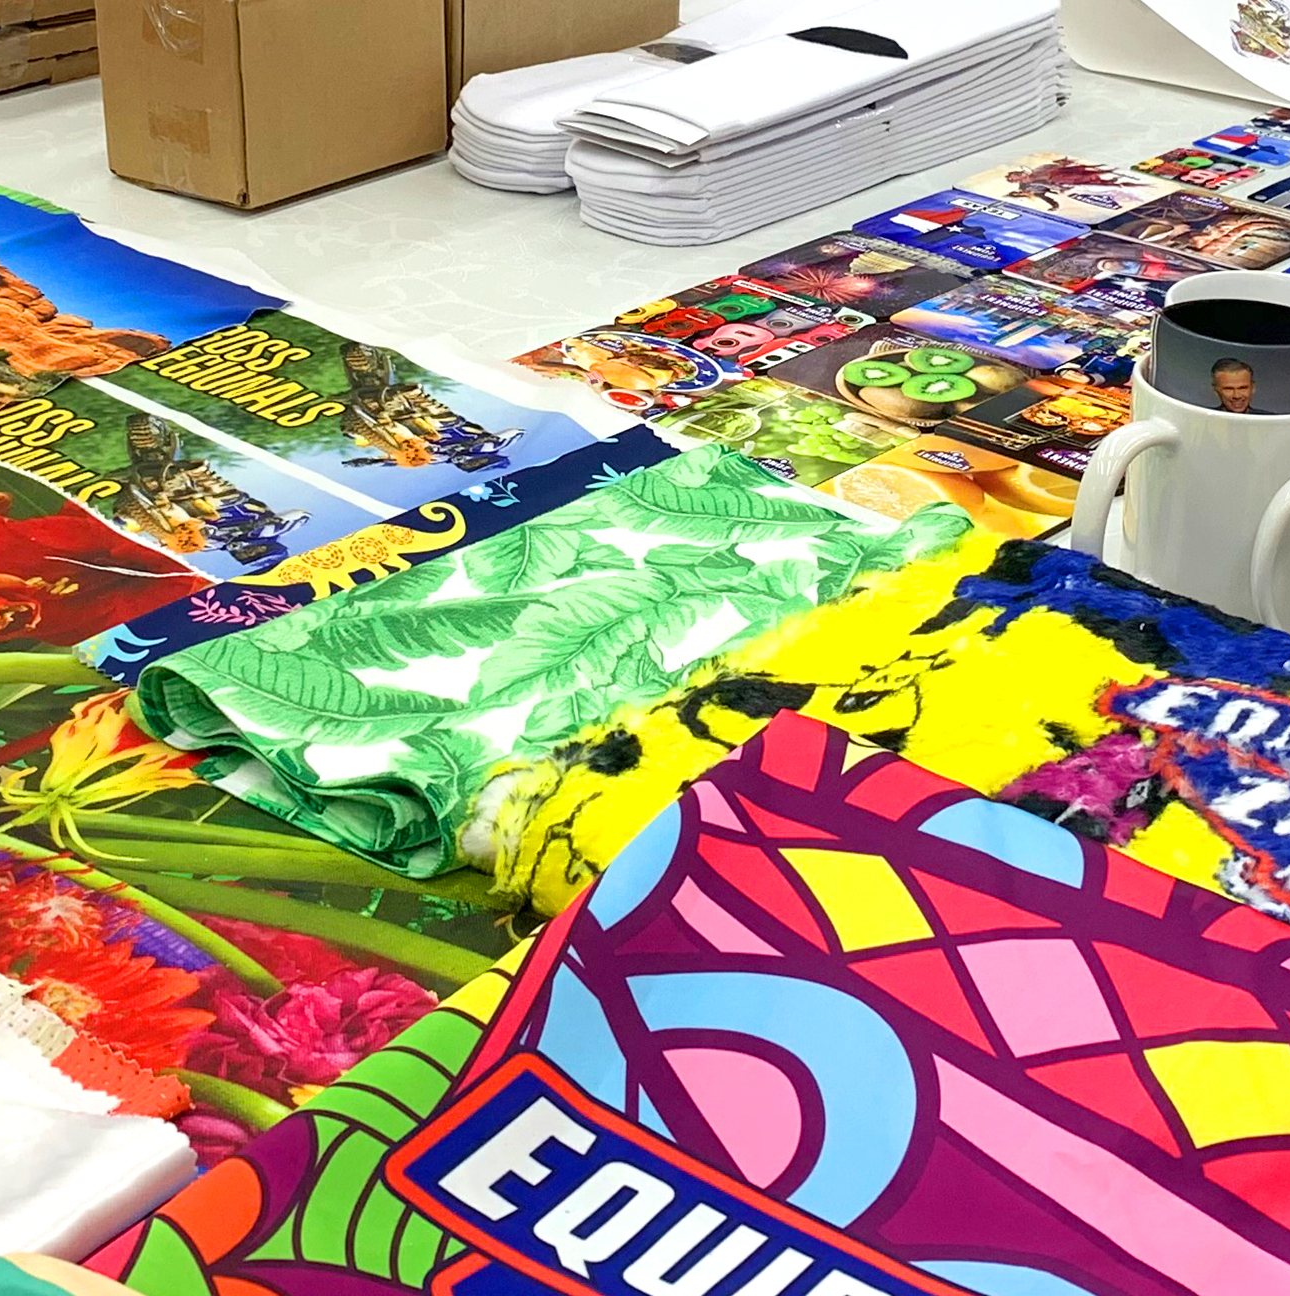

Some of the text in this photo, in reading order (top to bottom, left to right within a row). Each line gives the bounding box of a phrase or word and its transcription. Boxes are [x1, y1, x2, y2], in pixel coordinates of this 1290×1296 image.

[961, 201, 1006, 216] TEXAS
[951, 244, 1001, 262] EQUIPMENT
[980, 293, 1048, 316] EQUIPMENT
[1005, 295, 1037, 308] ZONE
[1087, 288, 1157, 312] EQUIPMENT
[1112, 290, 1147, 302] ZONE
[917, 449, 972, 471] EQUIPMENT
[937, 451, 966, 462] ZONE
[437, 1095, 886, 1296] EQUI
